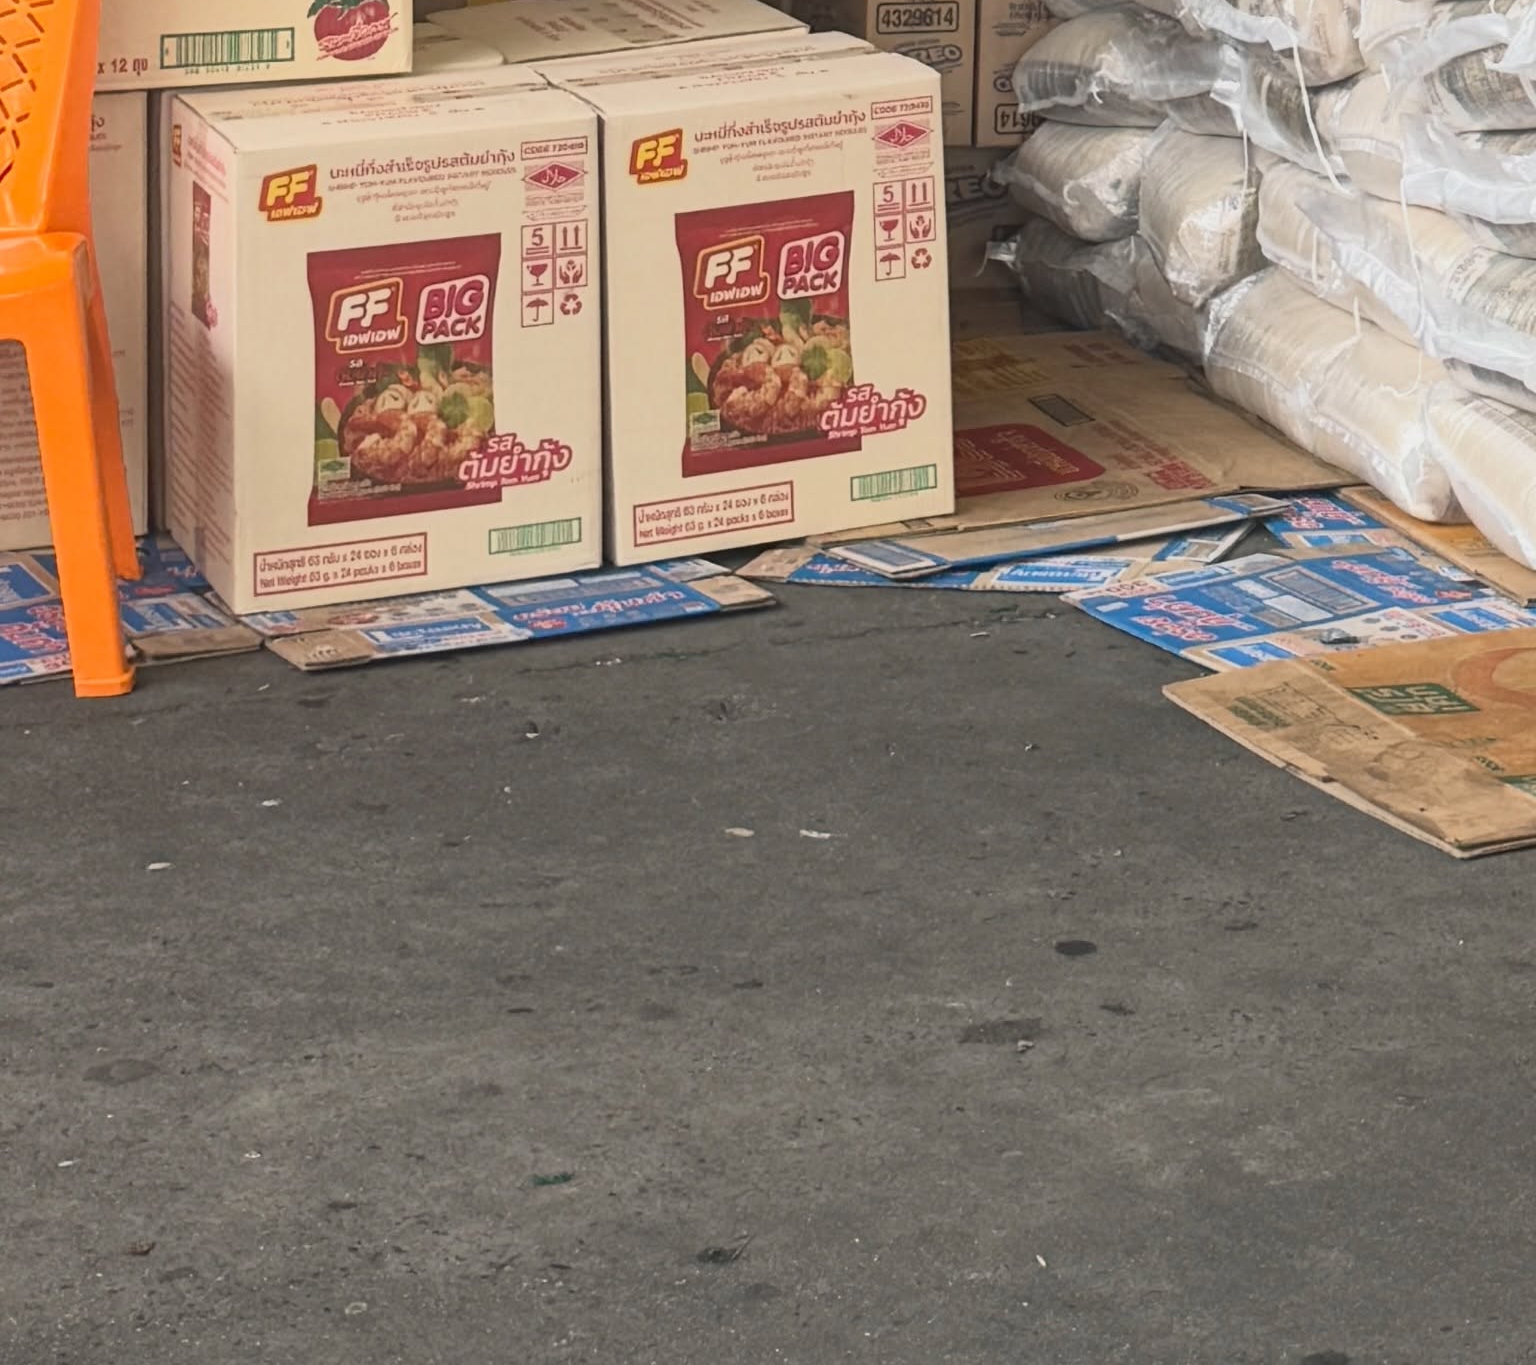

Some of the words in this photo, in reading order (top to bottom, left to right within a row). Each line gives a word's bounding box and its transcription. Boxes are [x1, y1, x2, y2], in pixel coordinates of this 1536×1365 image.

[881, 7, 954, 27] 4329614
[112, 59, 127, 74] 12
[530, 229, 543, 248] 5
[704, 245, 754, 289] FF
[784, 235, 840, 277] BIG
[782, 271, 838, 295] PACK
[337, 287, 392, 332] FF
[424, 279, 484, 322] BIG
[421, 315, 481, 341] PACK
[847, 384, 874, 402] รส
[820, 388, 925, 431] ต้มยำกุ้ง
[487, 435, 515, 454] รส
[458, 441, 571, 482] ต้มยำกุ้ง
